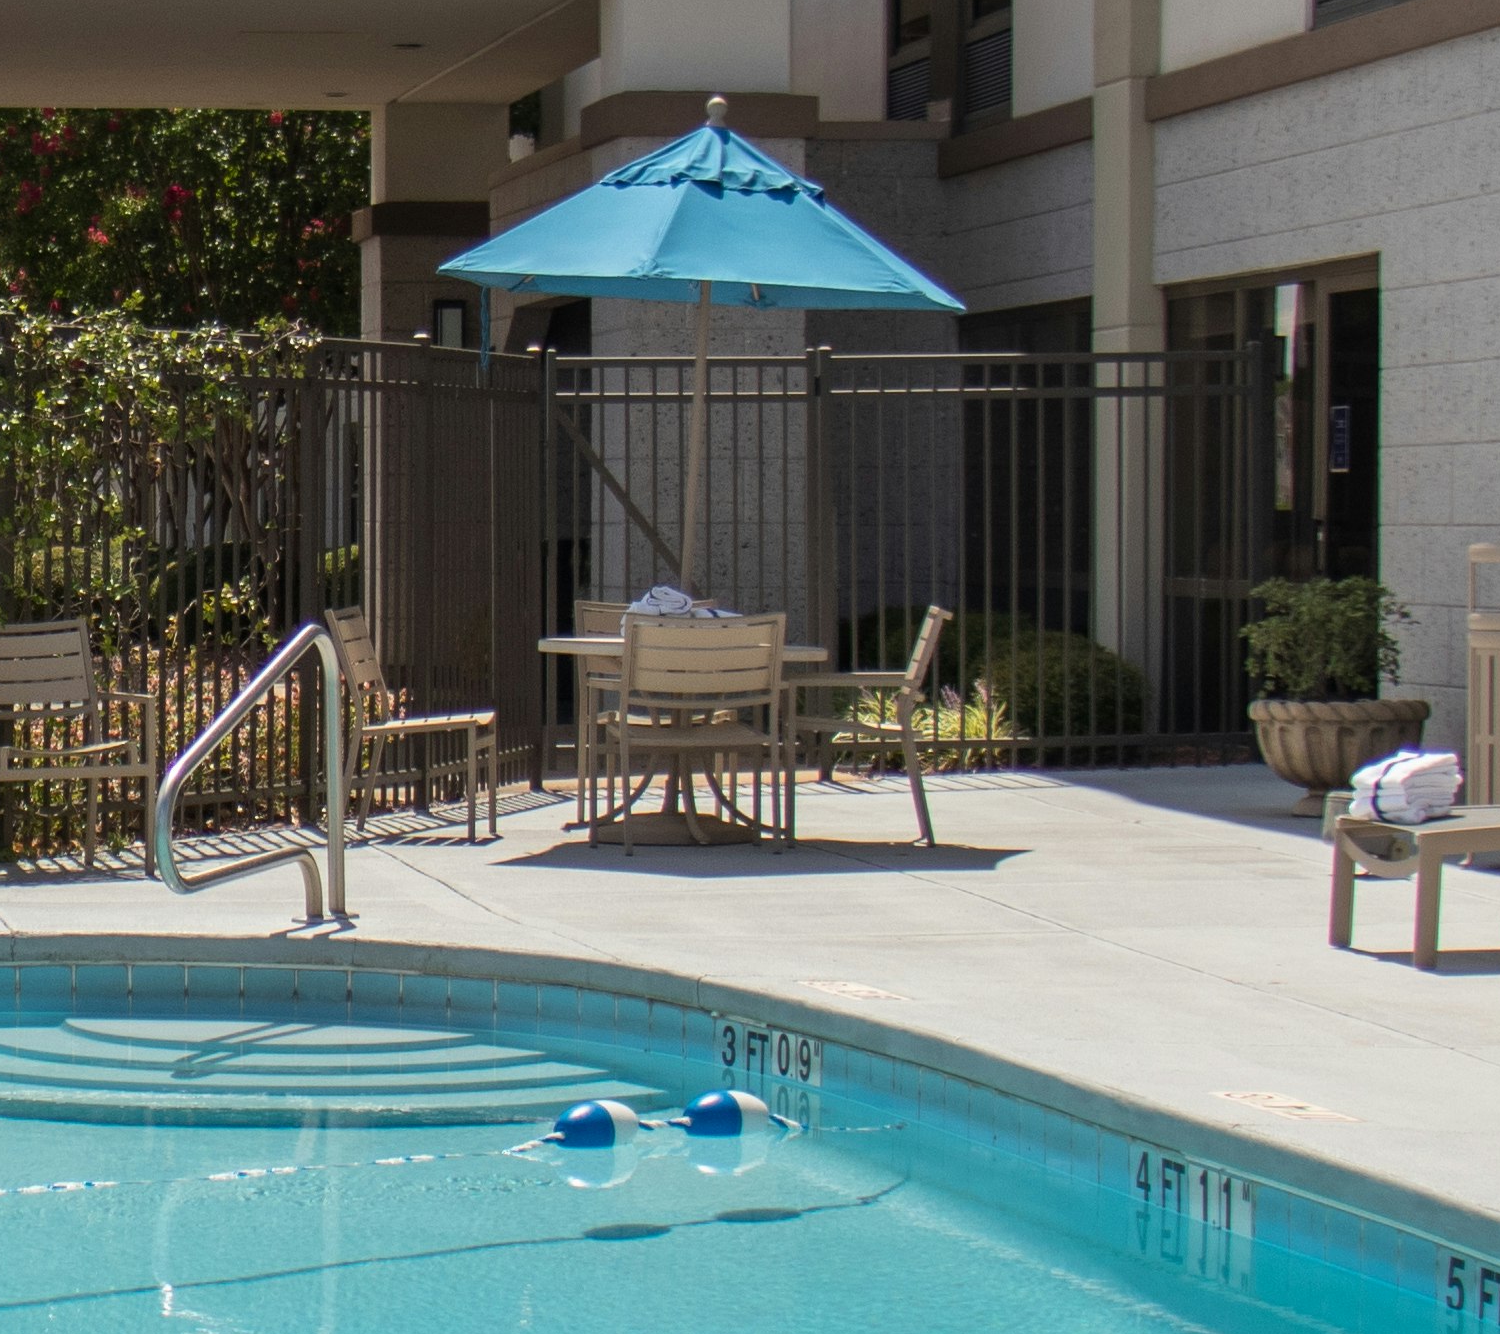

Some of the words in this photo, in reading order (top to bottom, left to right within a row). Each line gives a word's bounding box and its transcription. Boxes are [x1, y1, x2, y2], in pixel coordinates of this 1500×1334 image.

[721, 1025, 736, 1067] 3
[746, 1030, 769, 1075] FT
[1136, 1151, 1151, 1202] 4
[1161, 1157, 1186, 1214] FT
[1446, 1255, 1465, 1311] 5
